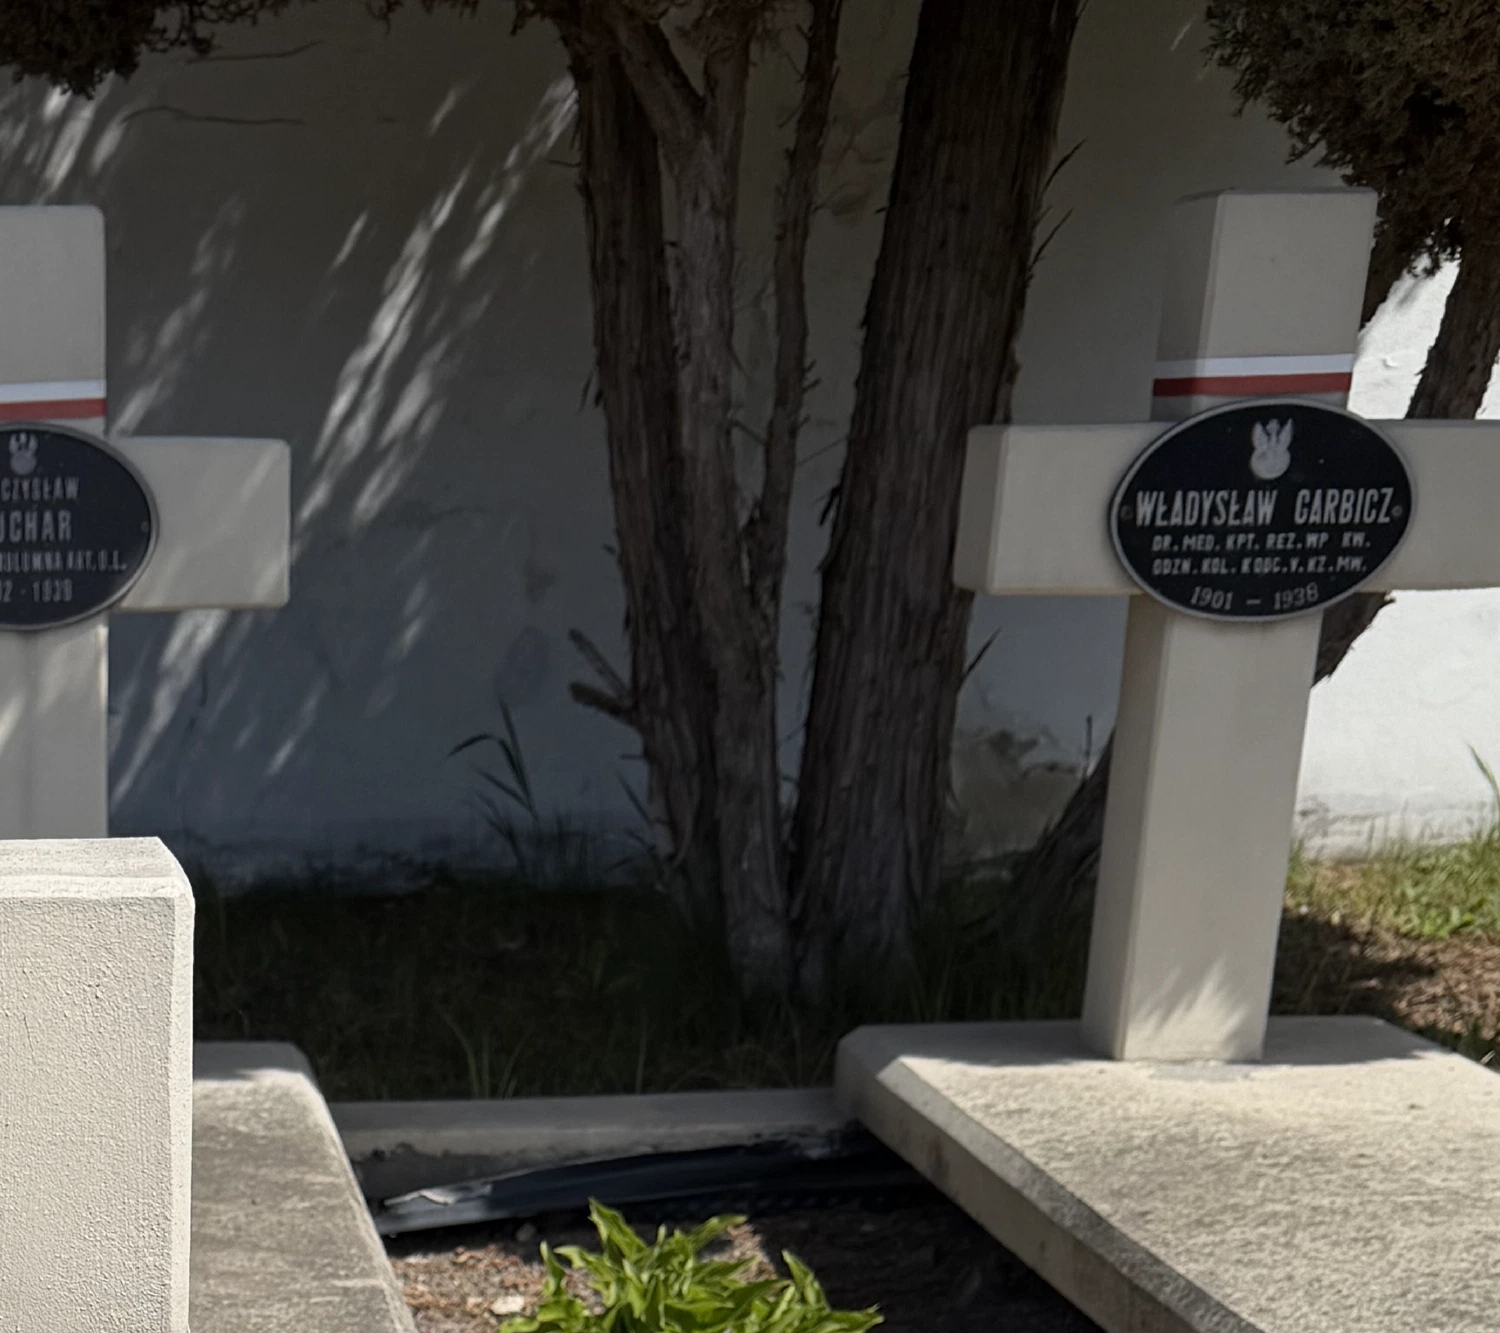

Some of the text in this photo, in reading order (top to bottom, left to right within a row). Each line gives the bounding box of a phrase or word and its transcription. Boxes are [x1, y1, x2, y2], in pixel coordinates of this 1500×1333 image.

[1136, 488, 1278, 526] WŁADYSŁAW
[1181, 533, 1221, 552] MED.
[1225, 532, 1260, 551] KPT.
[1190, 585, 1233, 611] 1901
[1273, 581, 1319, 610] 1938
